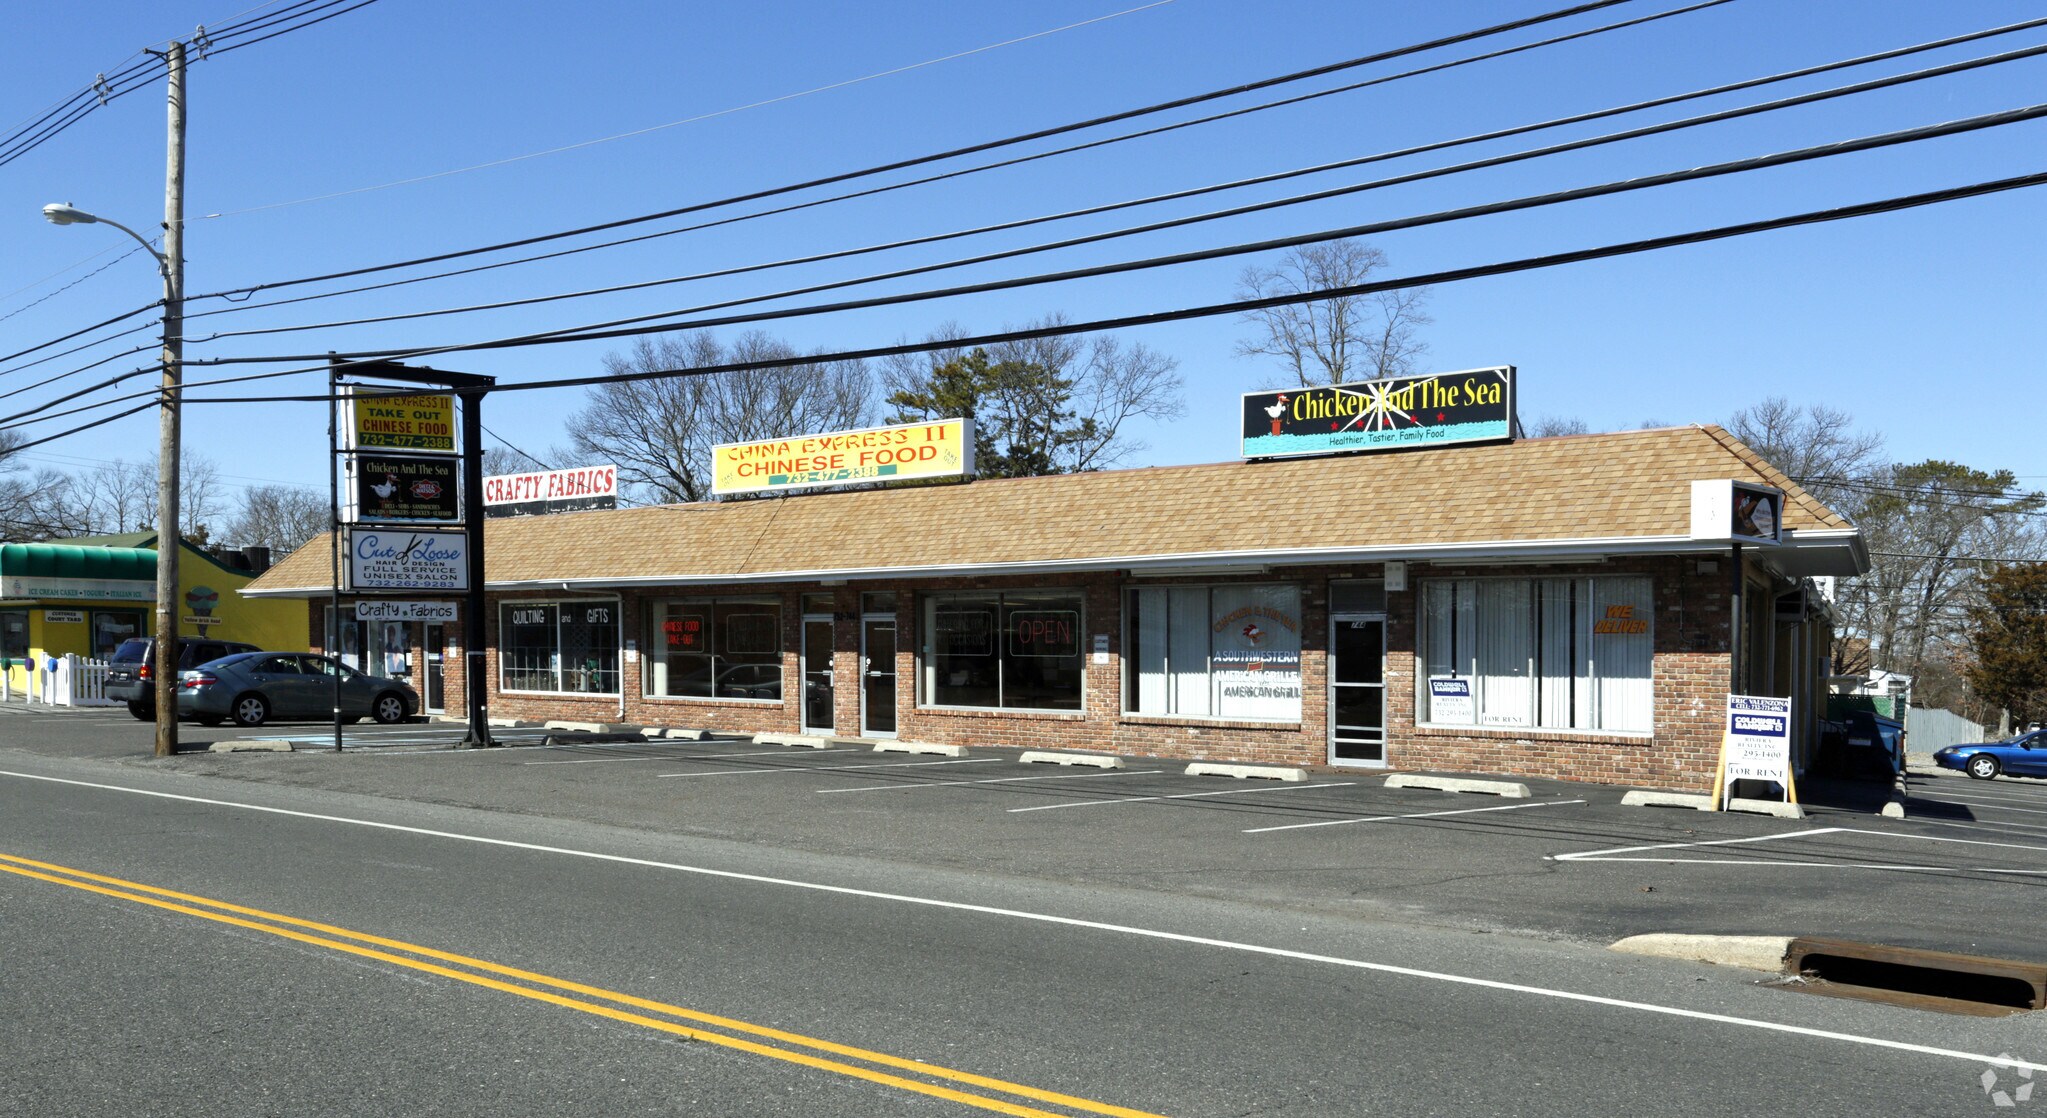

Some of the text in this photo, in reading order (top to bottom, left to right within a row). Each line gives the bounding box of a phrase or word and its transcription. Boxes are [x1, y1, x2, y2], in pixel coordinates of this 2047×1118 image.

[394, 395, 437, 409] EXPRESS
[1293, 378, 1501, 421] Chicken And The Sea
[367, 408, 442, 421] TAKE OUT
[363, 419, 448, 436] CHINESE FOOD
[363, 434, 451, 449] 732-477-2388
[727, 425, 947, 461] CHINA EXPRESS II
[1329, 428, 1445, 446] Healthier, Tastier, Family Food
[366, 462, 449, 475] Chicken And The Sea
[737, 445, 938, 478] CHINESE FOOD
[786, 466, 879, 483] 732-477-2388
[486, 468, 614, 502] CRAFTY FABRICS
[357, 535, 461, 561] Cut Loose
[402, 566, 457, 574] SERVICE
[366, 580, 455, 588] 732-262-9283
[358, 602, 453, 617] Crafty Fabrics
[512, 608, 609, 624] QUILTING and GIFTS
[1605, 605, 1634, 618] WE
[1019, 620, 1072, 644] OPEN
[1593, 619, 1648, 634] DELIVER
[1213, 650, 1298, 663] A SOUTHWESTERN
[1216, 670, 1262, 681] AMERICAN
[1749, 698, 1789, 707] VALENZONA
[1743, 750, 1781, 758] 295-1400
[1730, 767, 1783, 778] FOR RENT
